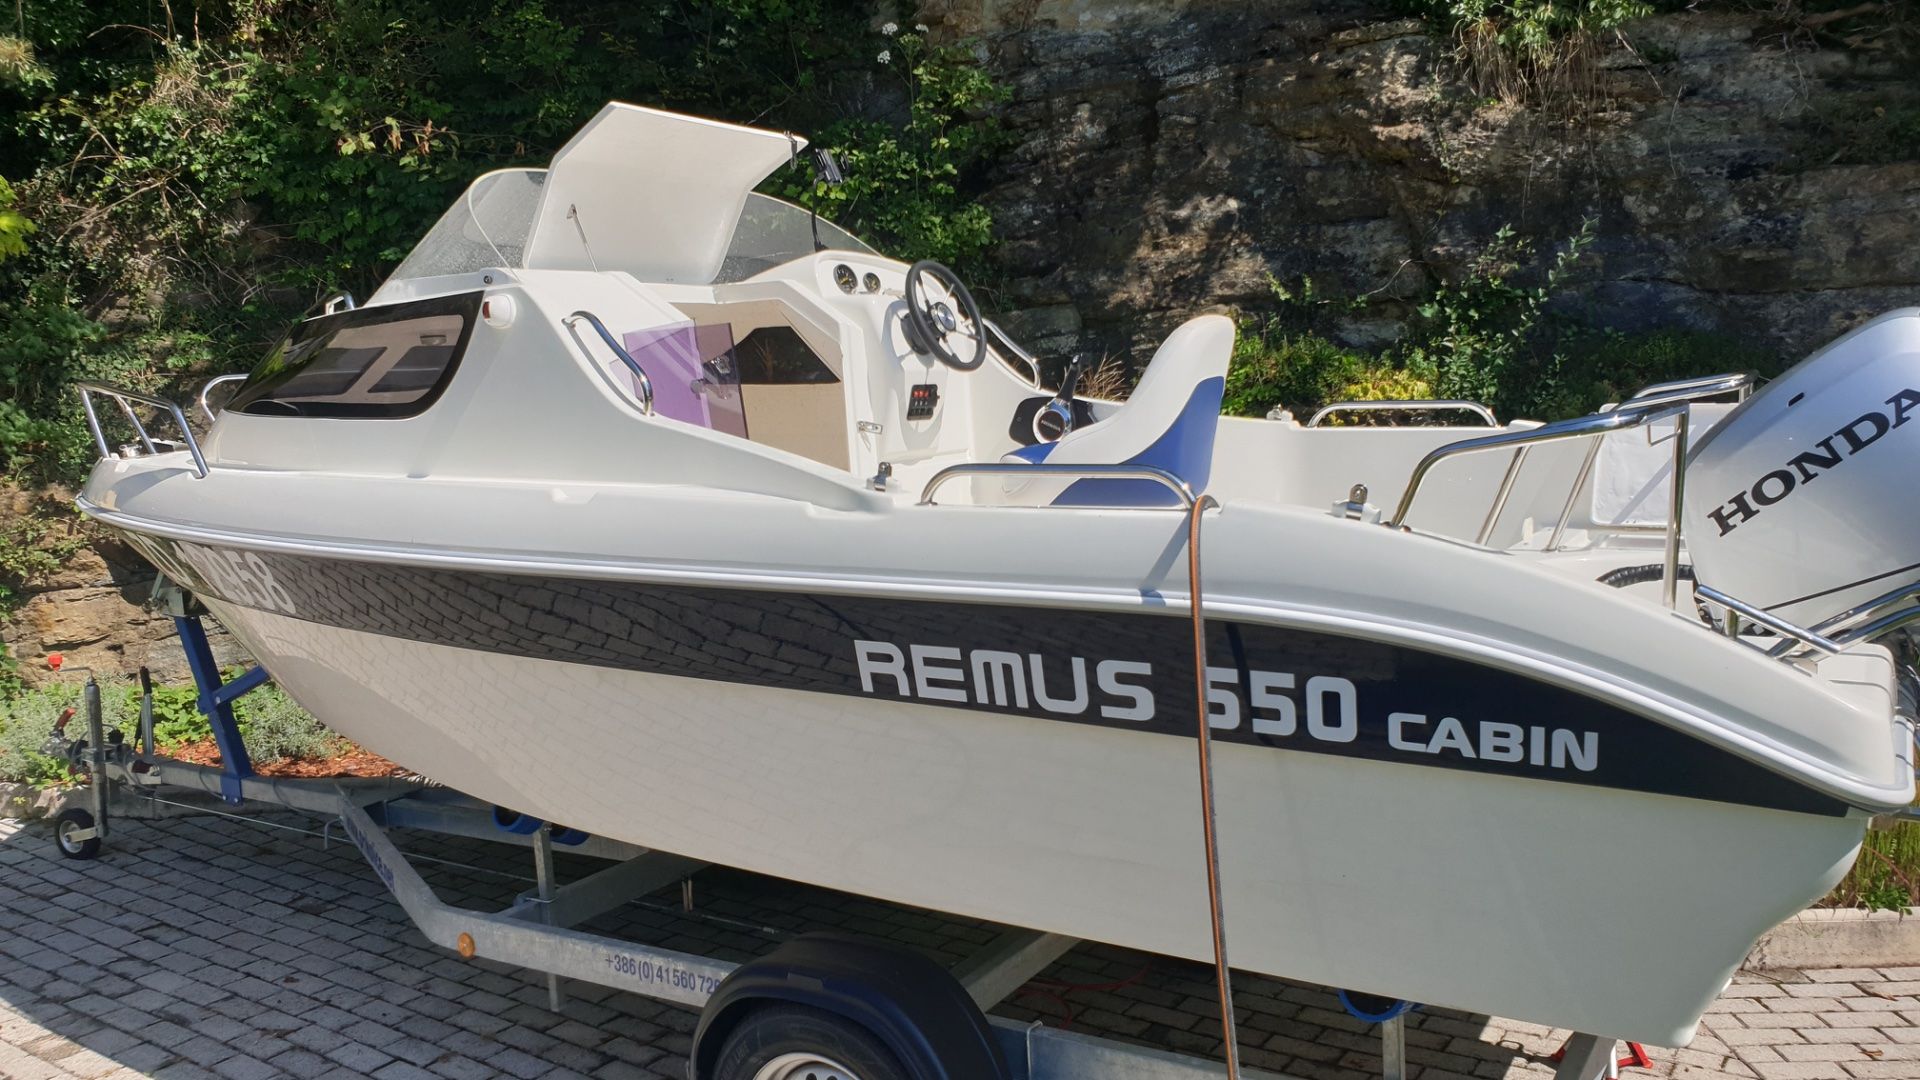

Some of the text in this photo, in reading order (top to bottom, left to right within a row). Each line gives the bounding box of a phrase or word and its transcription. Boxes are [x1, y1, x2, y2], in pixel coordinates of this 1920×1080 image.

[1707, 388, 1920, 538] HONDA
[853, 639, 1599, 772] REMUS 550 CABIN
